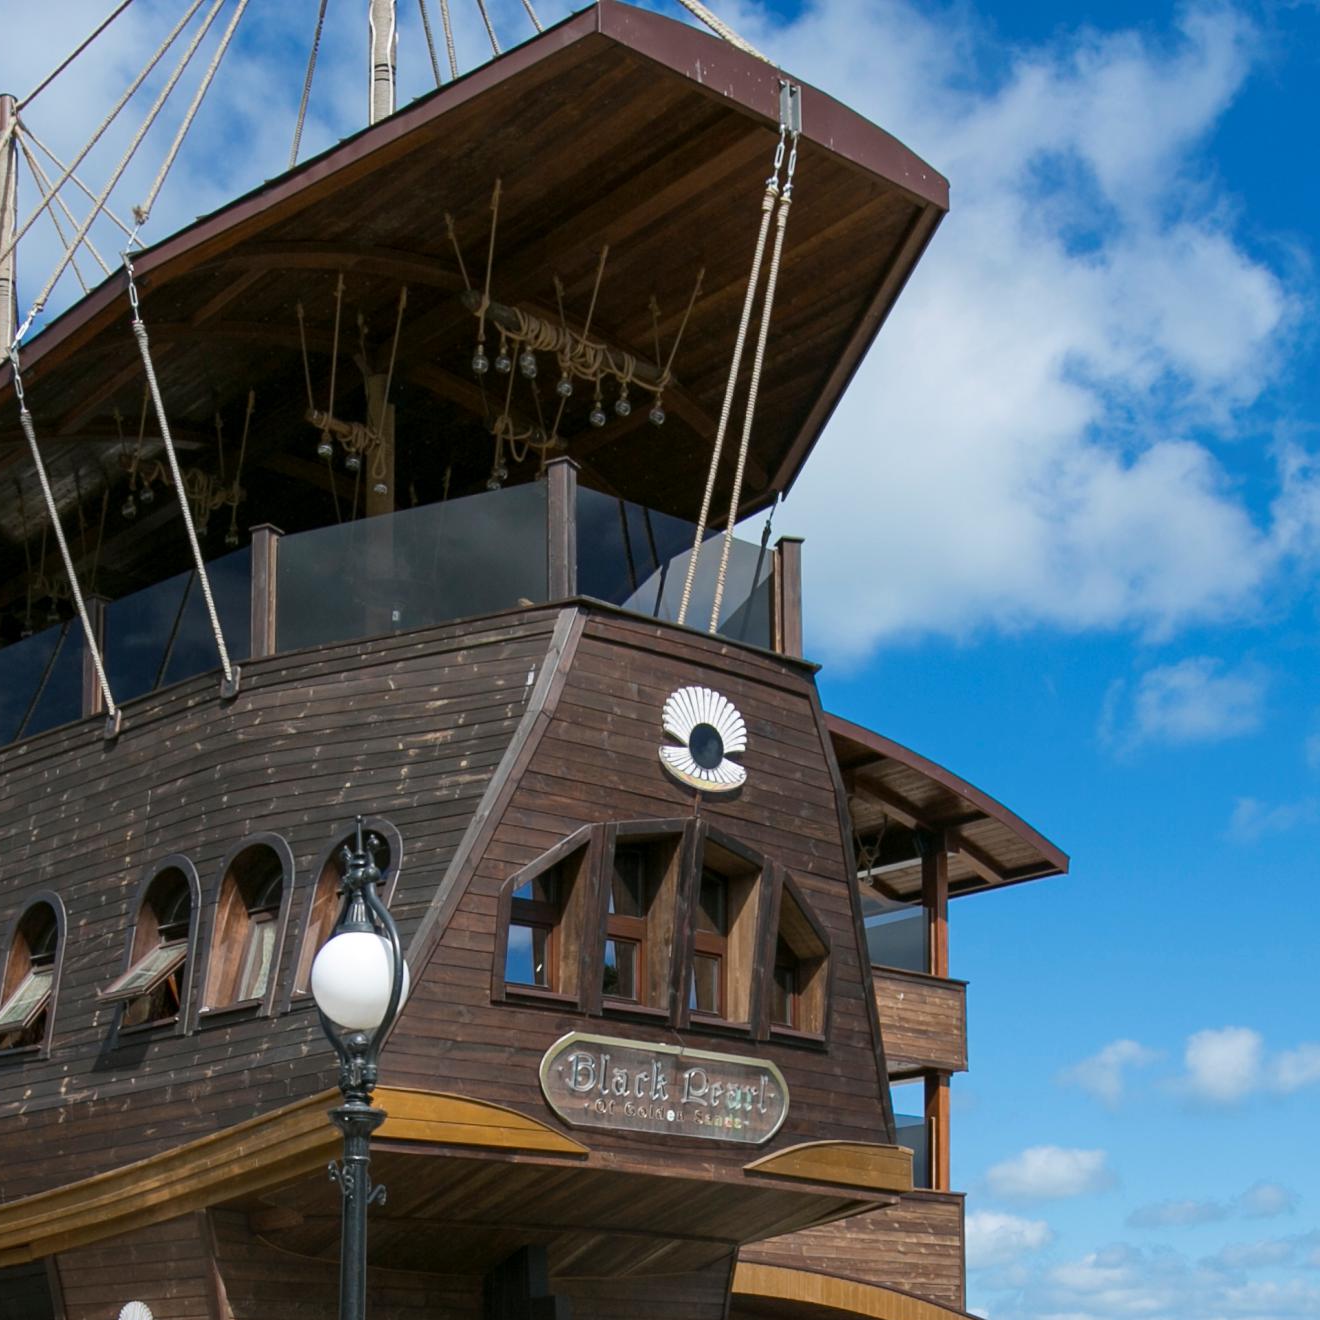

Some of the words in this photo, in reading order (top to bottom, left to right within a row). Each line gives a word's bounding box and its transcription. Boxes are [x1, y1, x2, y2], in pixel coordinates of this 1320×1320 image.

[566, 1051, 669, 1101] Black
[681, 1067, 769, 1114] Pearl
[594, 1098, 615, 1113] Of
[623, 1101, 684, 1121] Golden
[694, 1109, 743, 1129] Sands
